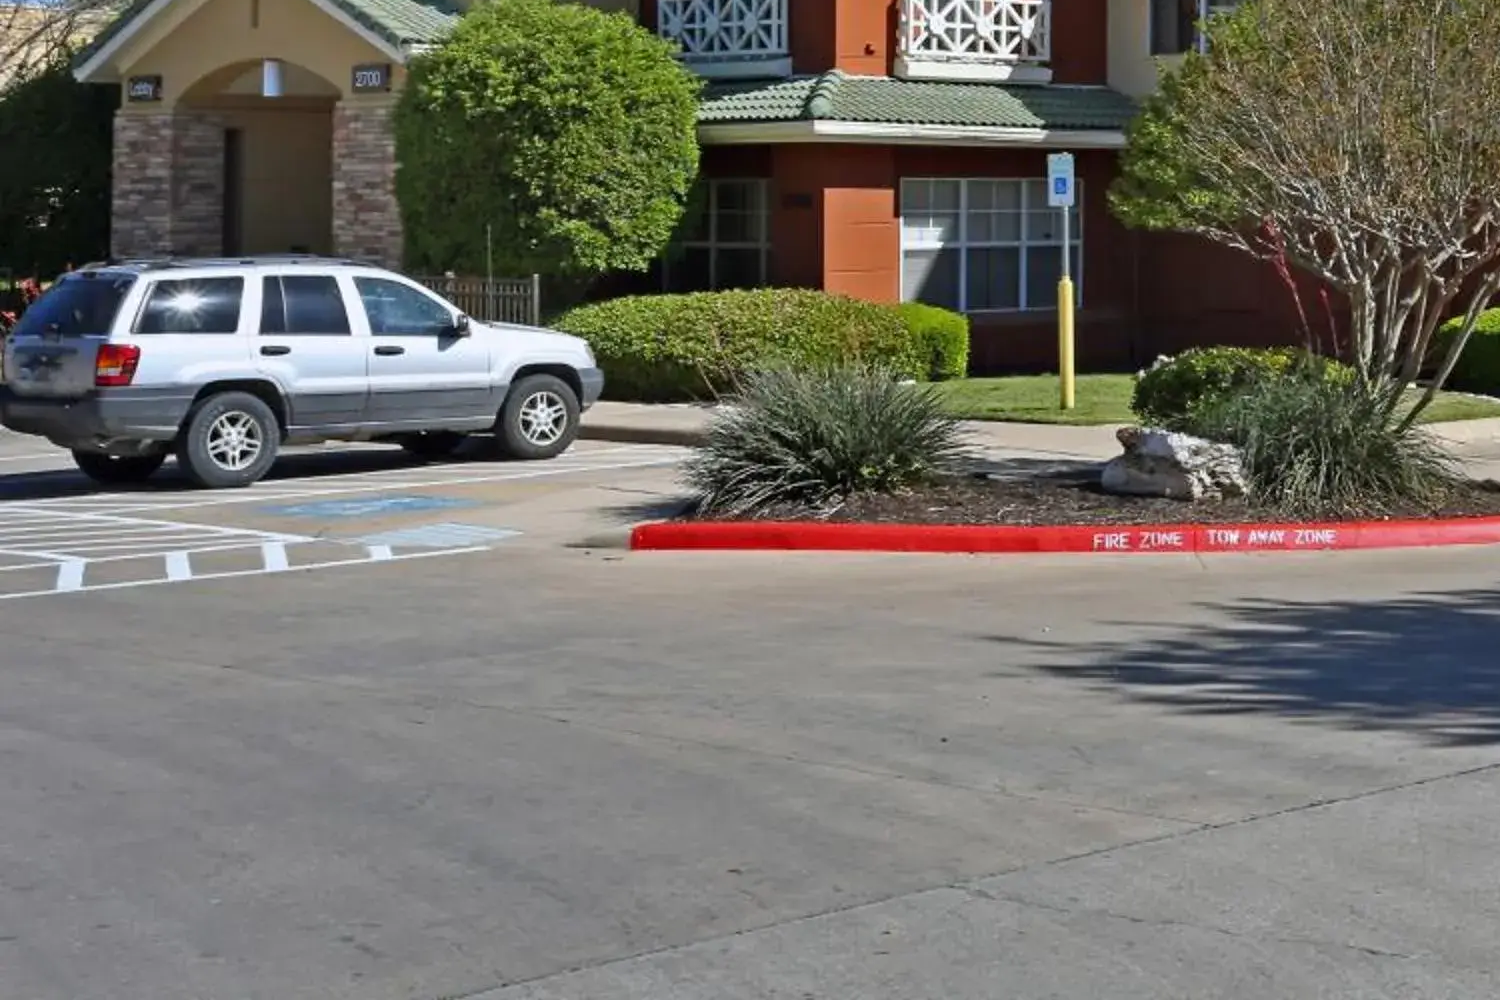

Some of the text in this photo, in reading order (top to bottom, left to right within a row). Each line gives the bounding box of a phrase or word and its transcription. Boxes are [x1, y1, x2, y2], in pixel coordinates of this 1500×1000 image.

[1093, 529, 1336, 549] FIRE ZONE TOW AWAY ZONE
